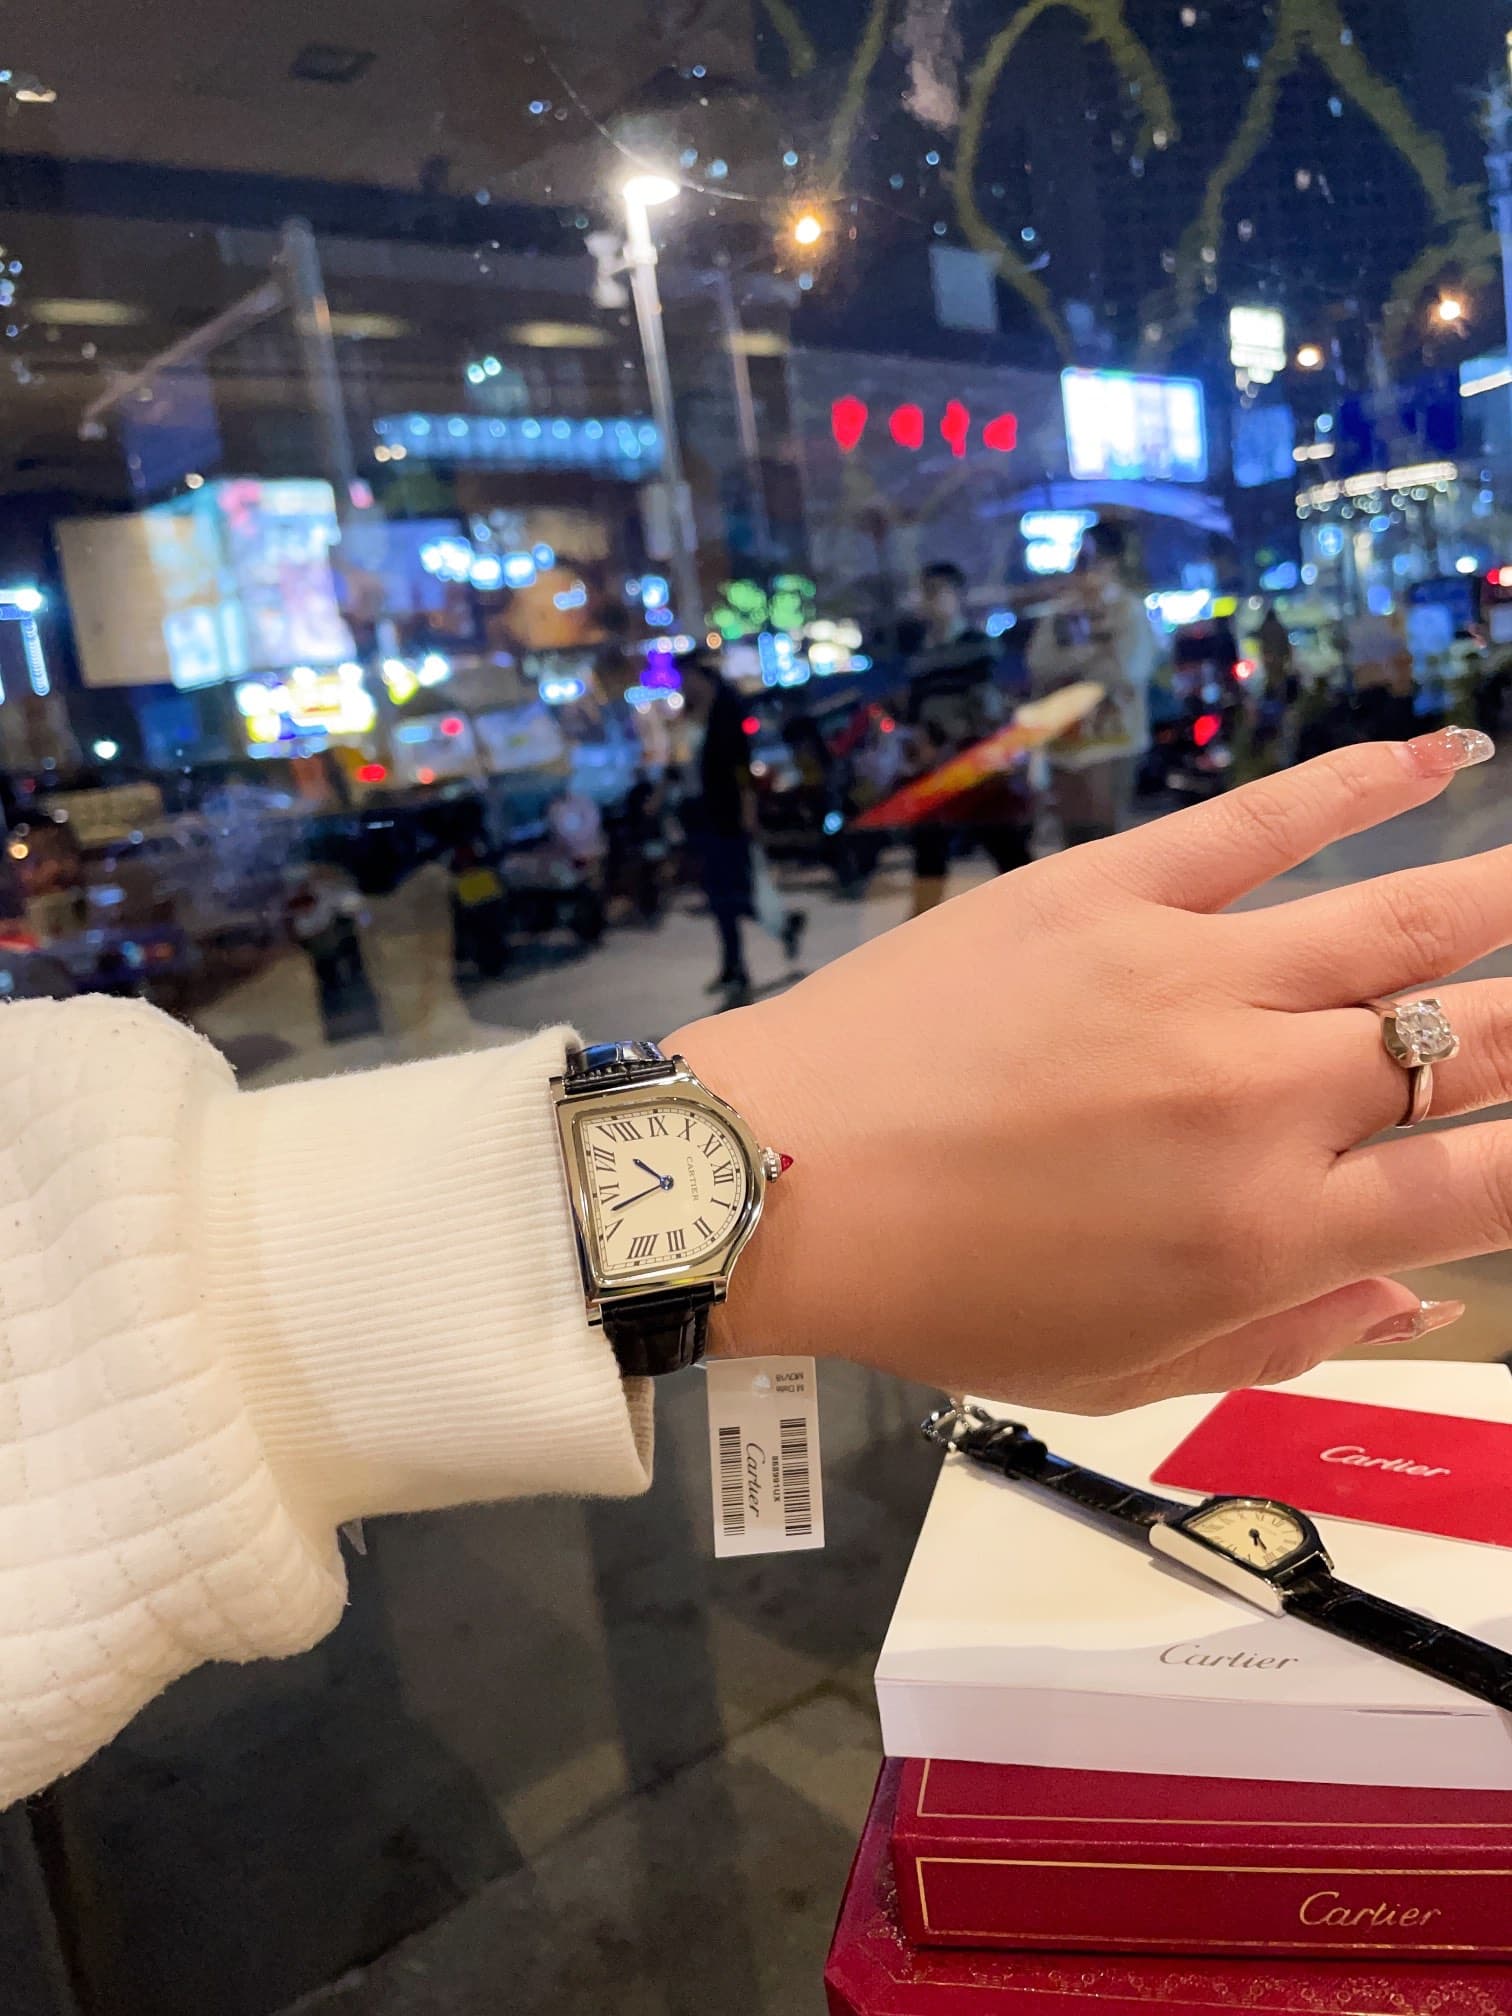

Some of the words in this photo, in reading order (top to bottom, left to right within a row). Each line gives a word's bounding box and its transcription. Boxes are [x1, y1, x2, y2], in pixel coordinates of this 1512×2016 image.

[596, 1121, 643, 1143] VIII
[647, 1115, 669, 1138] IX
[678, 1118, 697, 1141] X
[698, 1134, 722, 1158] XI
[686, 1156, 699, 1201] CARTIER
[711, 1161, 734, 1186] XII
[710, 1197, 731, 1209] I
[605, 1217, 624, 1242] V
[666, 1229, 686, 1252] III
[693, 1217, 714, 1240] II
[1320, 1445, 1451, 1479] Cartier
[746, 1442, 765, 1517] Cartier
[1159, 1644, 1300, 1670] Cartier
[1299, 1892, 1441, 1927] Cartier
